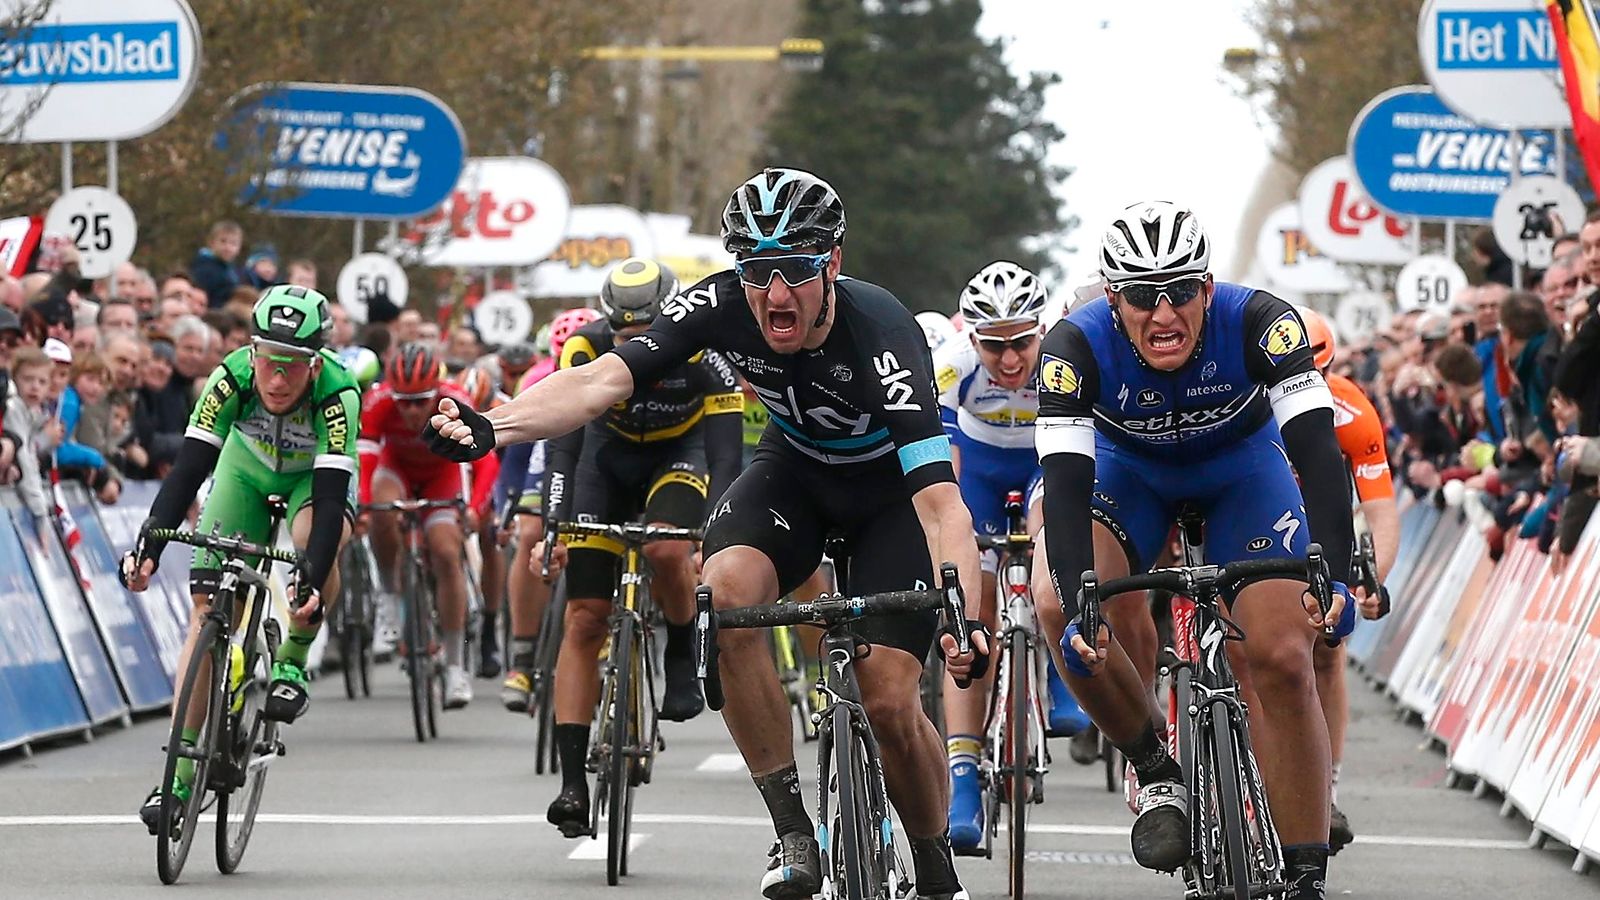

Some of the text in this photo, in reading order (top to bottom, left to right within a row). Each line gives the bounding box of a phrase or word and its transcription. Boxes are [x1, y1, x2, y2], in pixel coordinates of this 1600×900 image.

[1442, 18, 1506, 62] Het
[276, 126, 408, 168] VENISE
[1416, 131, 1544, 171] VENISE
[70, 214, 112, 250] 25
[357, 275, 389, 301] 50
[1417, 277, 1449, 303] 50
[747, 356, 765, 364] 21ST
[747, 362, 784, 374] CENTURY
[748, 367, 764, 375] FOX
[1186, 383, 1232, 397] latexco
